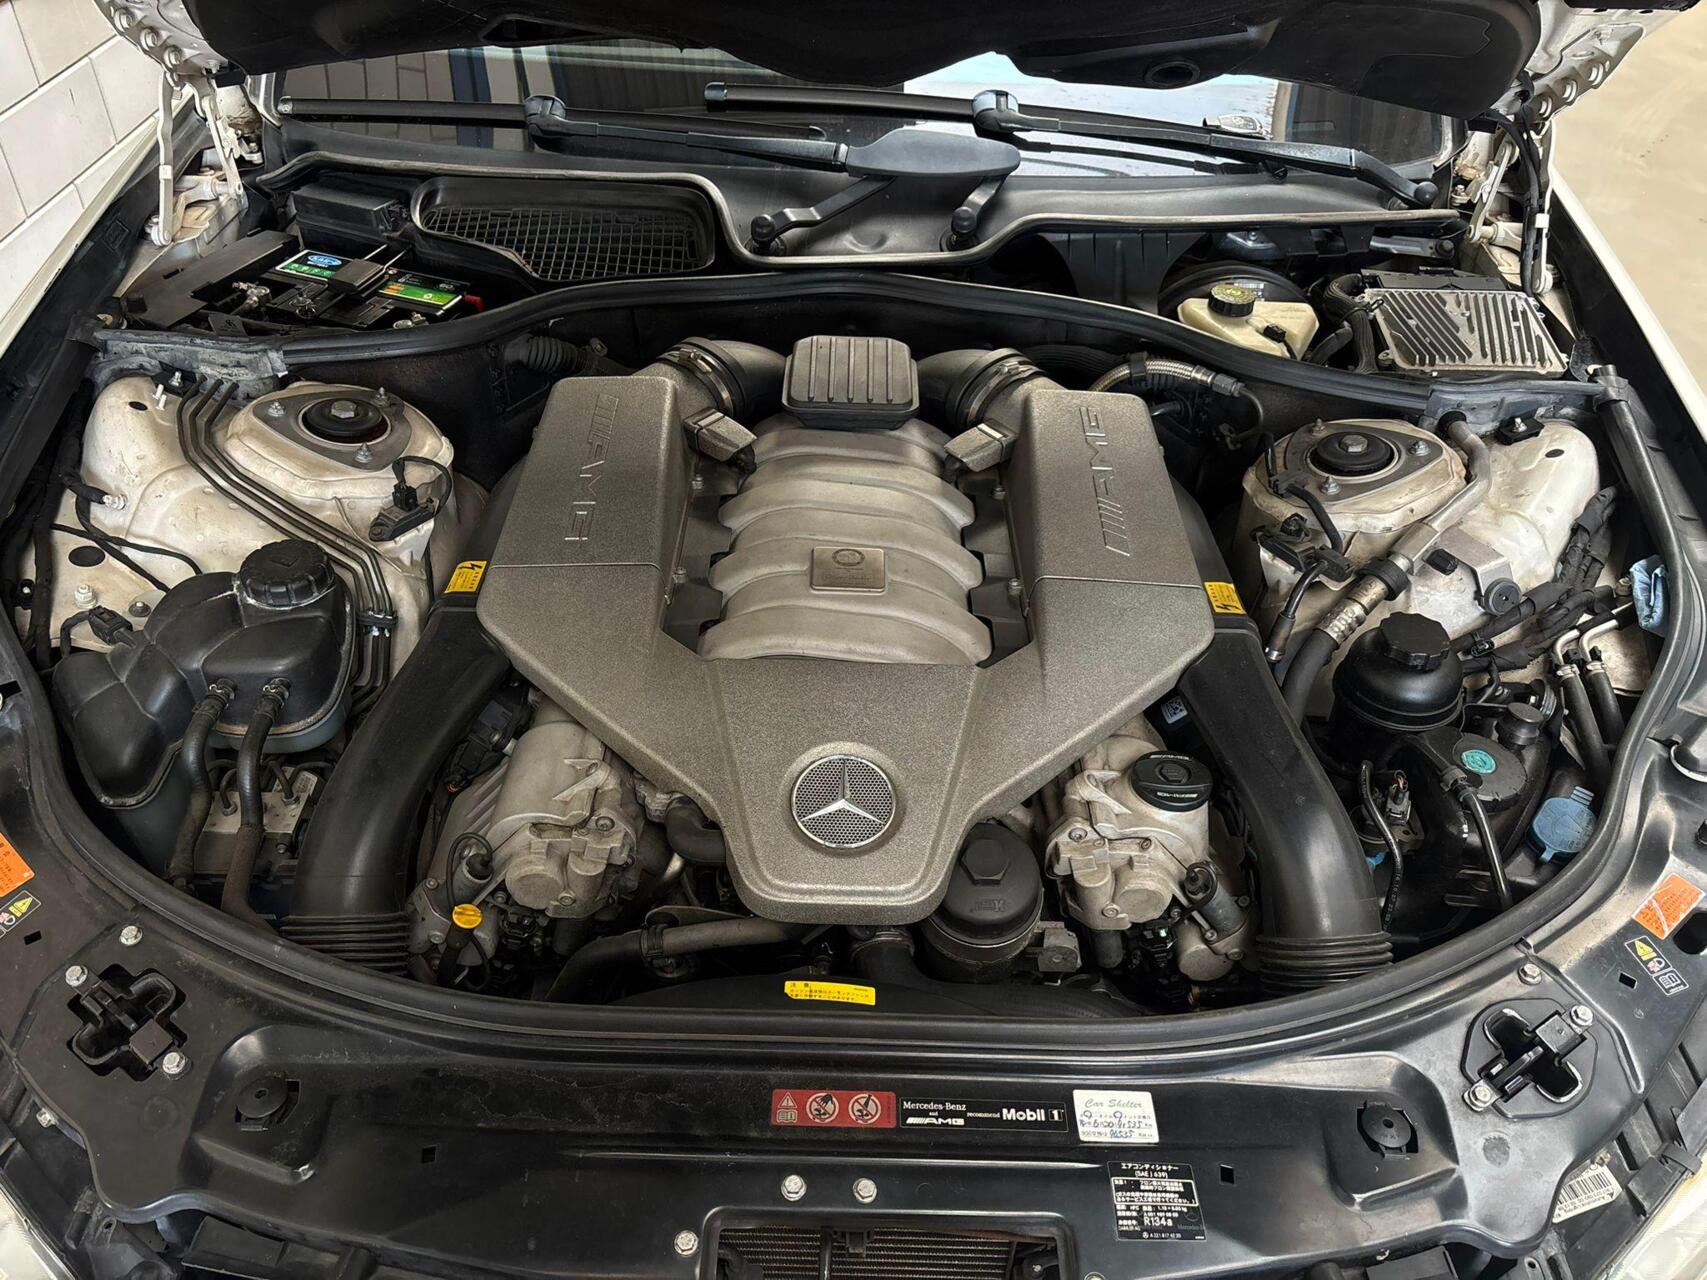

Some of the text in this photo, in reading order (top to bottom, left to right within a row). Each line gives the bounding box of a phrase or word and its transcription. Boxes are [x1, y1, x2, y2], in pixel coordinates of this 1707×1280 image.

[1079, 406, 1119, 506] AMG
[903, 1101, 967, 1111] Mercedes-Benz
[1084, 1098, 1143, 1109] Car Shelter
[1002, 1108, 1045, 1121] Mobil
[923, 1117, 965, 1126] AMG
[1144, 1217, 1173, 1226] R134a
